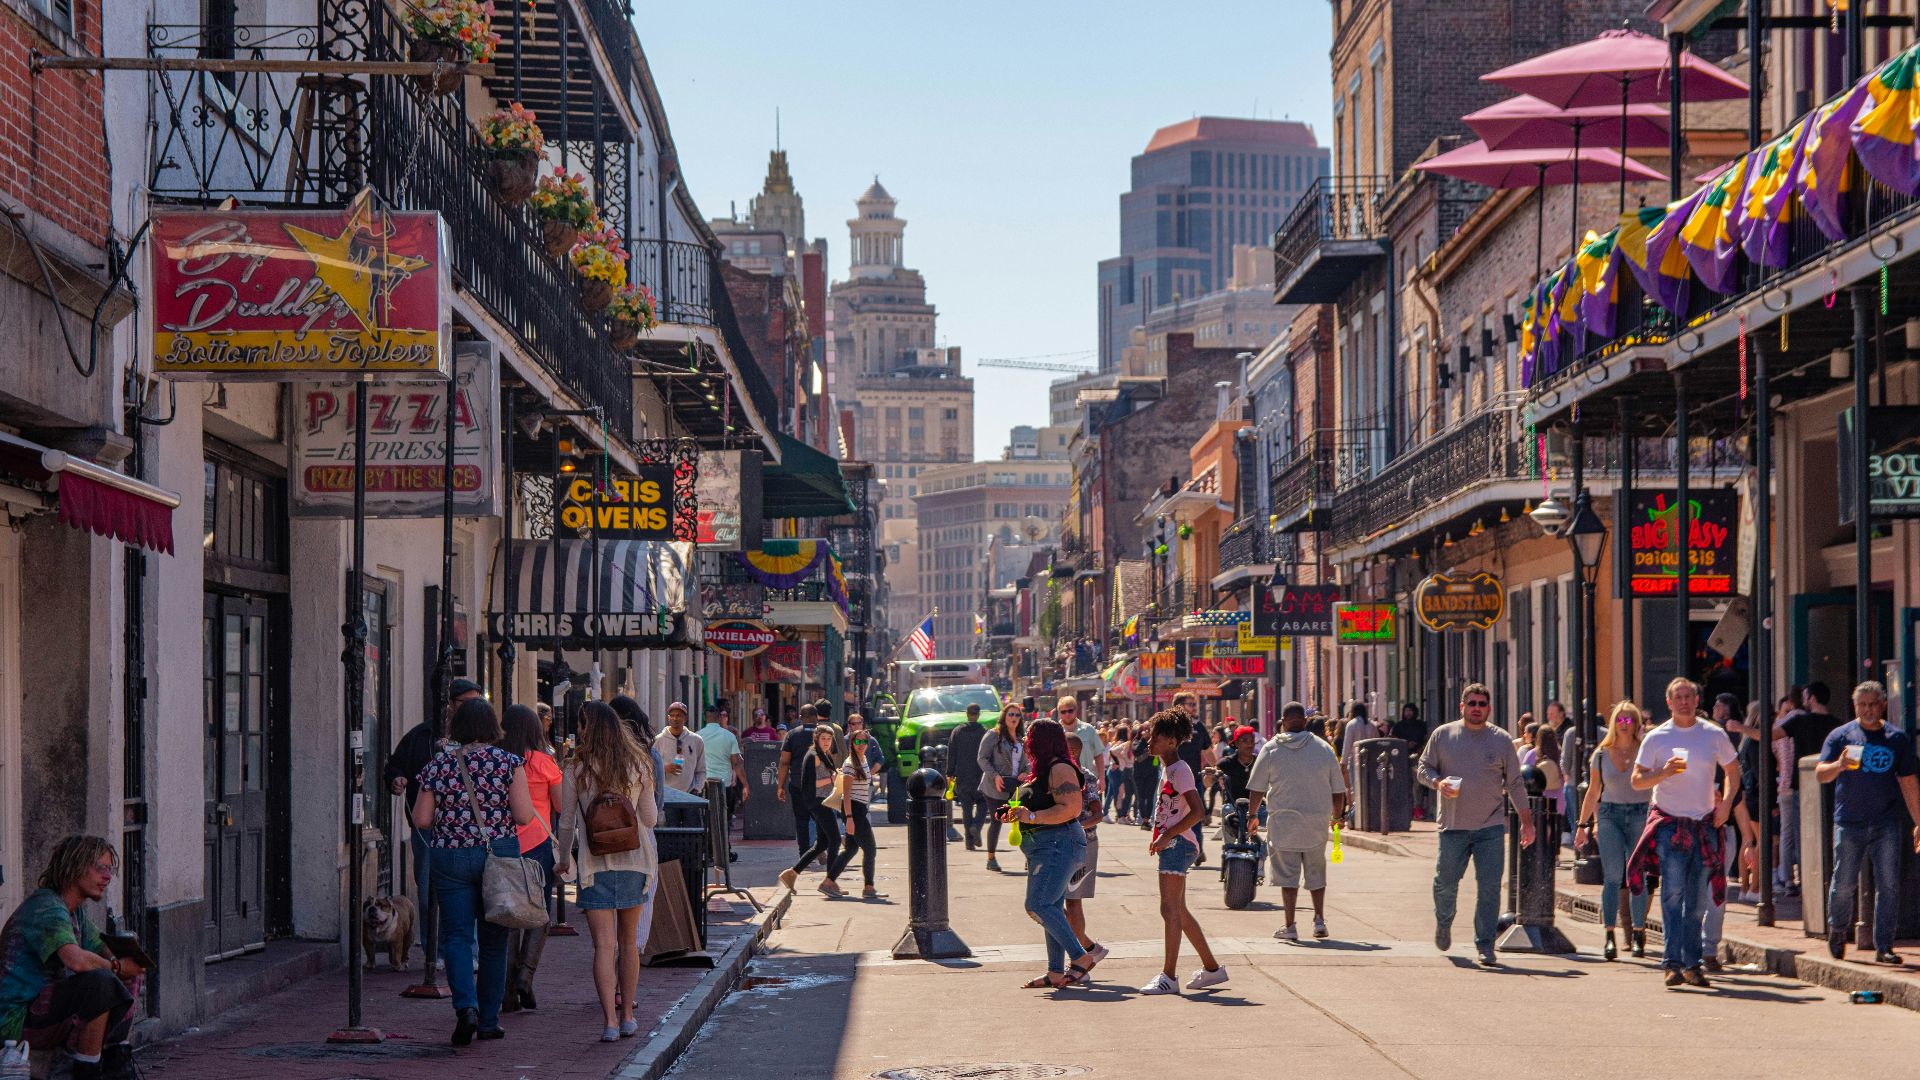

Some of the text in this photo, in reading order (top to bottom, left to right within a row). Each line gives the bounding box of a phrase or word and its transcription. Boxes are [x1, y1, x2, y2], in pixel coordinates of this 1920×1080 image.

[162, 277, 350, 341] Daddy's
[164, 335, 434, 369] Bottomless Topless
[306, 389, 480, 436] PIZZA
[335, 441, 448, 461] EPRESS
[393, 467, 424, 489] THE
[428, 468, 475, 489] SLCE
[561, 506, 667, 530] OWENS
[1632, 519, 1668, 549] BIG
[1423, 594, 1500, 612] BANDSTAND
[496, 614, 675, 637] CHRIS OWENS
[704, 630, 775, 643] DIXIELAND
[1246, 657, 1265, 675] CLUB
